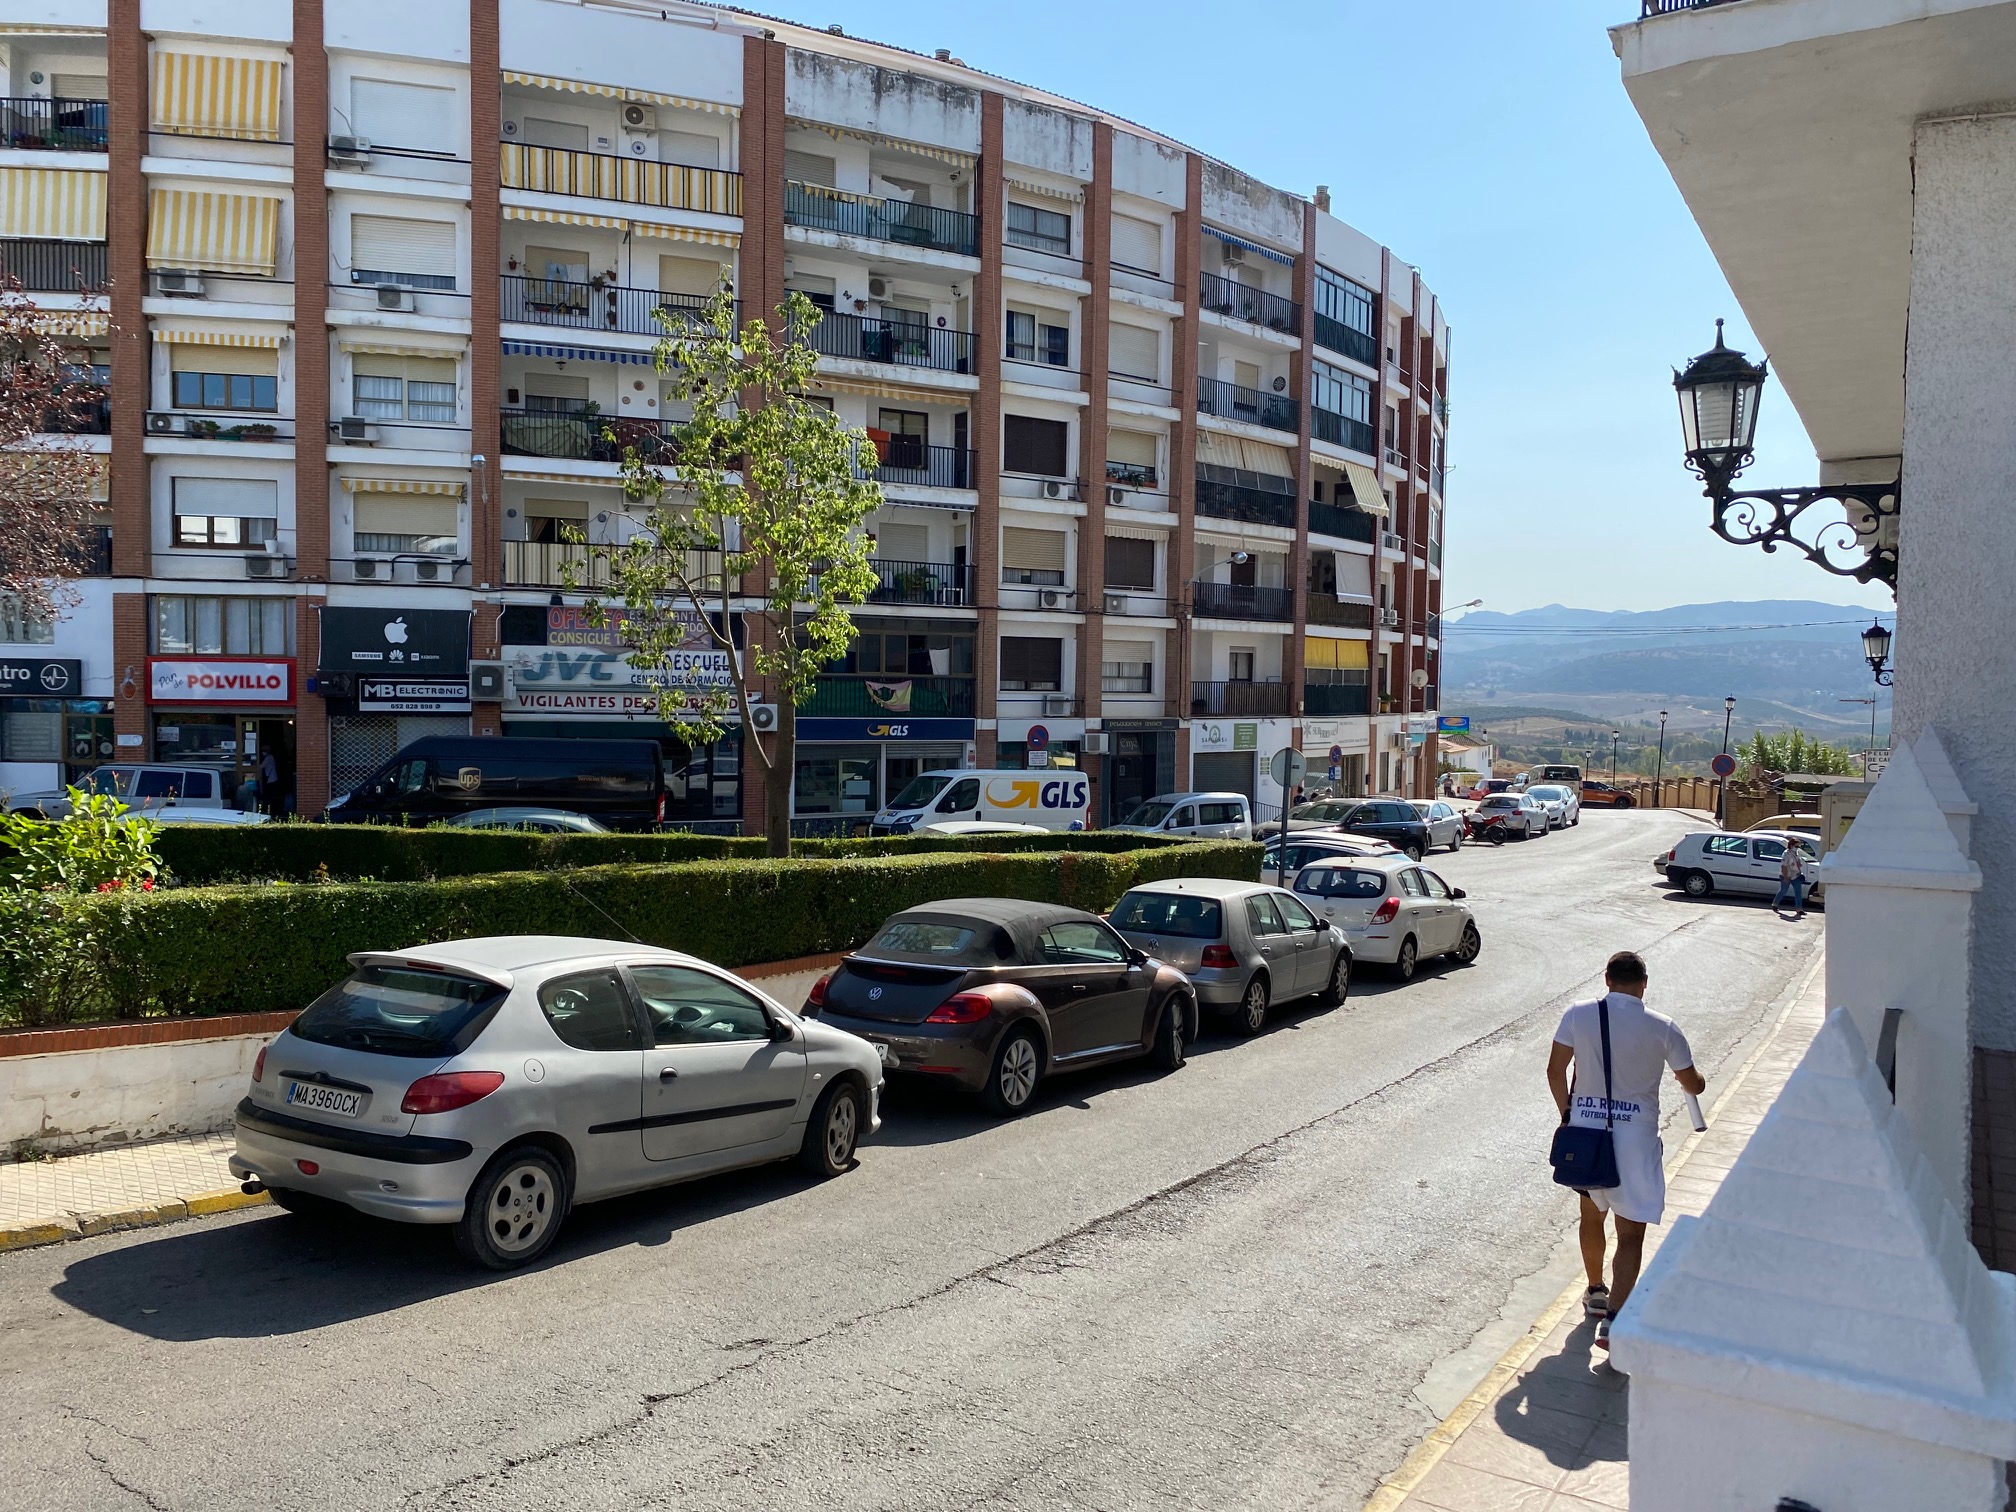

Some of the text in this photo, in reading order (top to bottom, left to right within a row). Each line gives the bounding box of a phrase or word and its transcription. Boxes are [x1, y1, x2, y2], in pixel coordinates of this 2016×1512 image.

[549, 607, 626, 630] OFETA
[549, 631, 611, 645] CONSIGUE
[523, 653, 617, 681] JVC
[158, 673, 177, 688] Pan
[173, 679, 183, 689] de
[187, 674, 281, 690] POLVILLO
[671, 675, 682, 684] DE
[364, 684, 464, 698] MB ELECTRONIC
[518, 695, 616, 708] VIGILANTES
[623, 697, 643, 709] DE
[889, 724, 909, 736] GLS
[460, 774, 480, 788] ups
[1041, 781, 1087, 809] GLS
[294, 1084, 360, 1115] MA3960CX
[1577, 1096, 1597, 1108] C.D.
